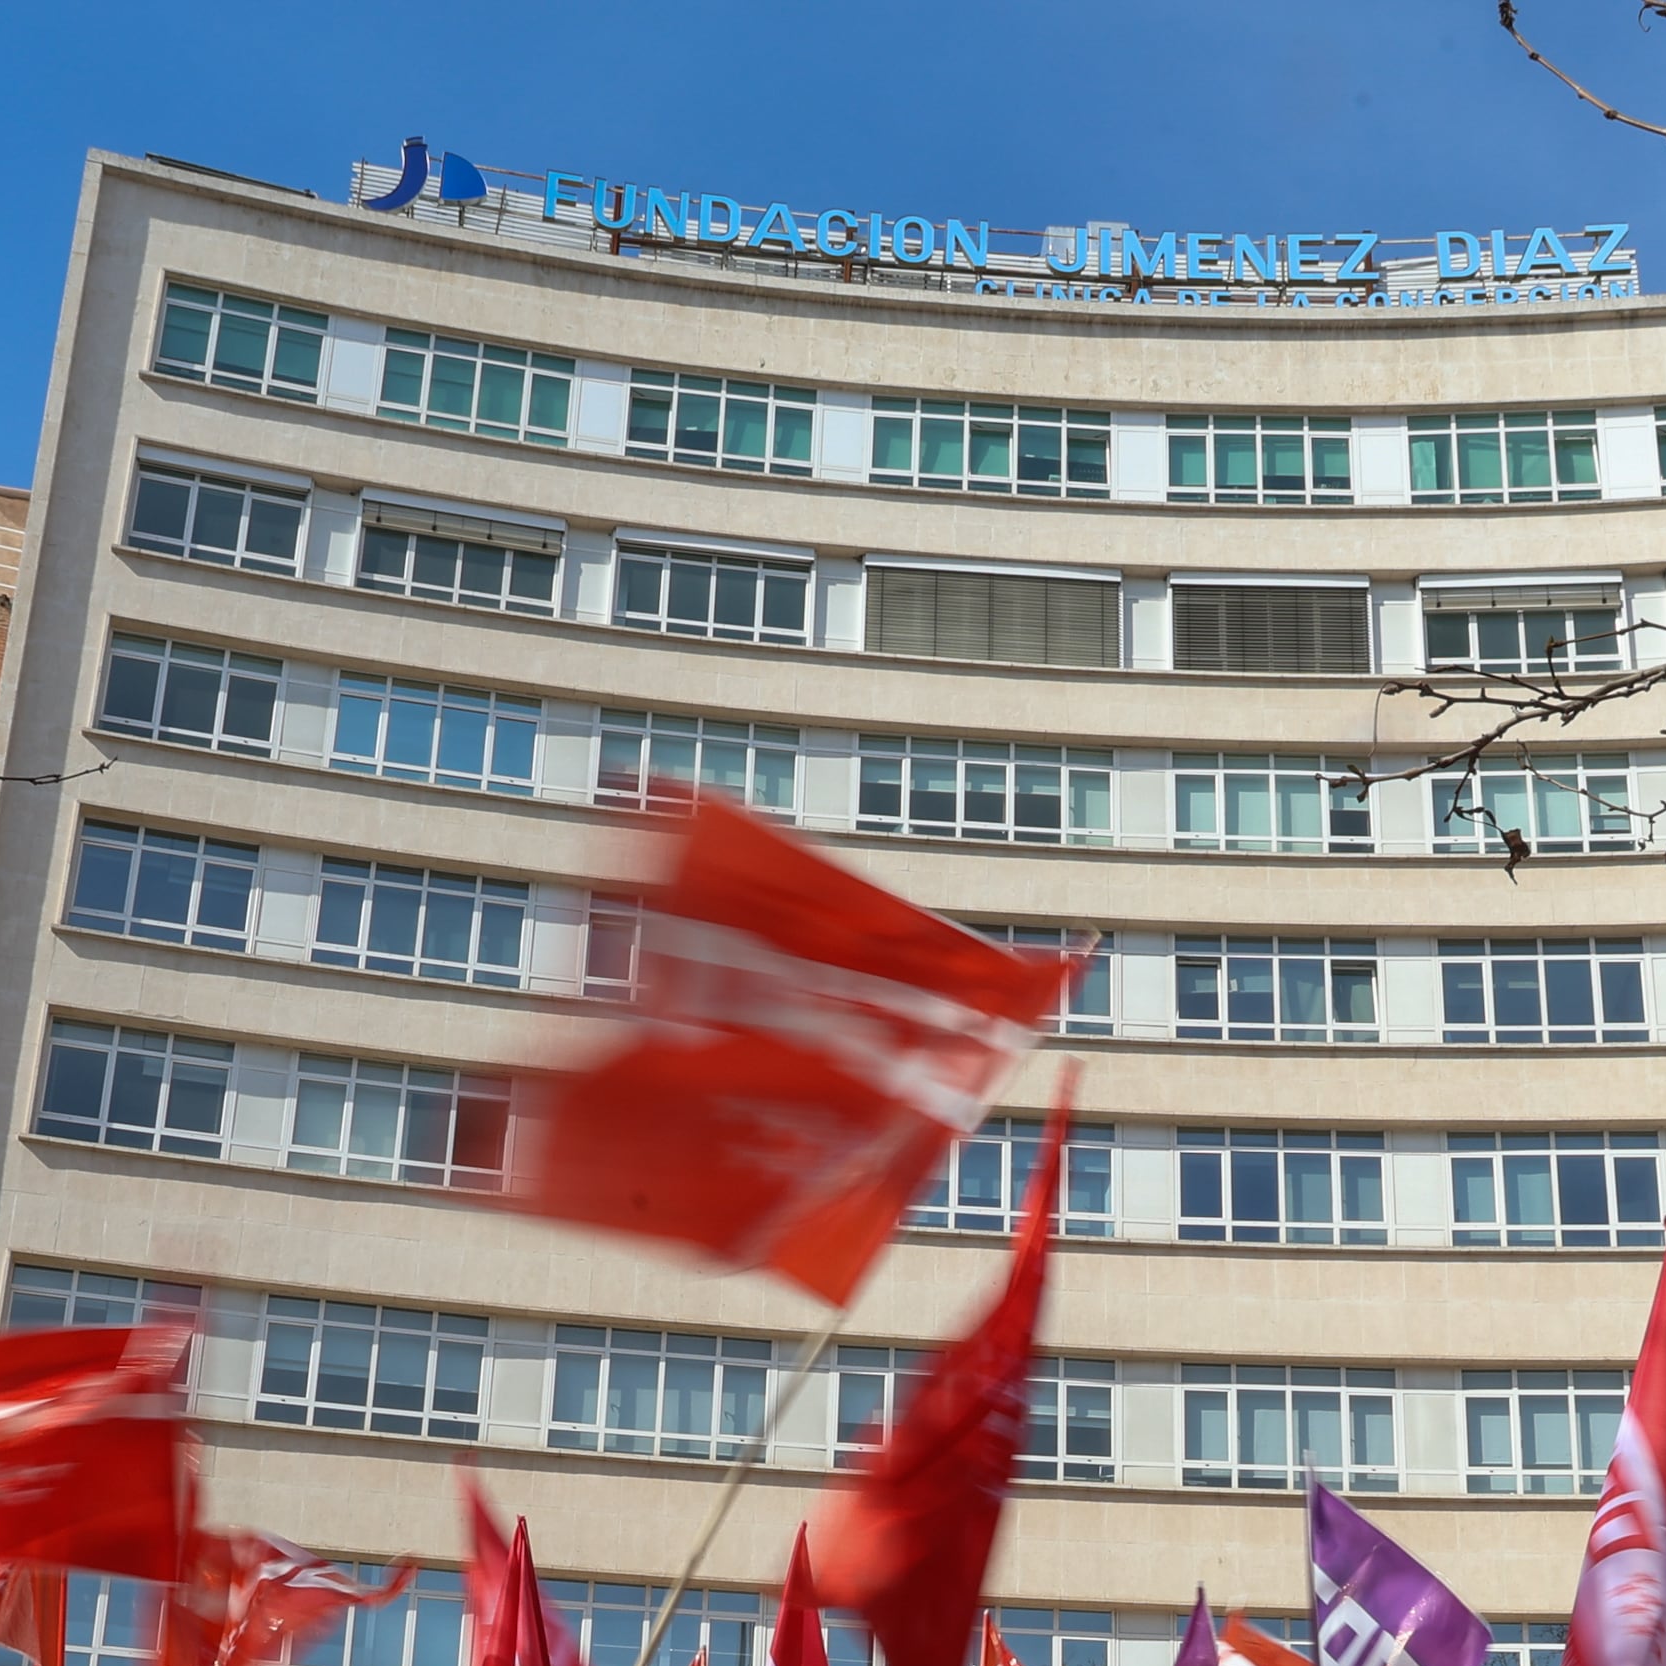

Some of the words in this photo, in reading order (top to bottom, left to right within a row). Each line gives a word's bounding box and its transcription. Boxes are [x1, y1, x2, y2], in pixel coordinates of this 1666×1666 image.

[542, 168, 990, 269] FUNDACION
[1045, 220, 1380, 282] JIMENEZ
[1435, 222, 1631, 281] DIAZ
